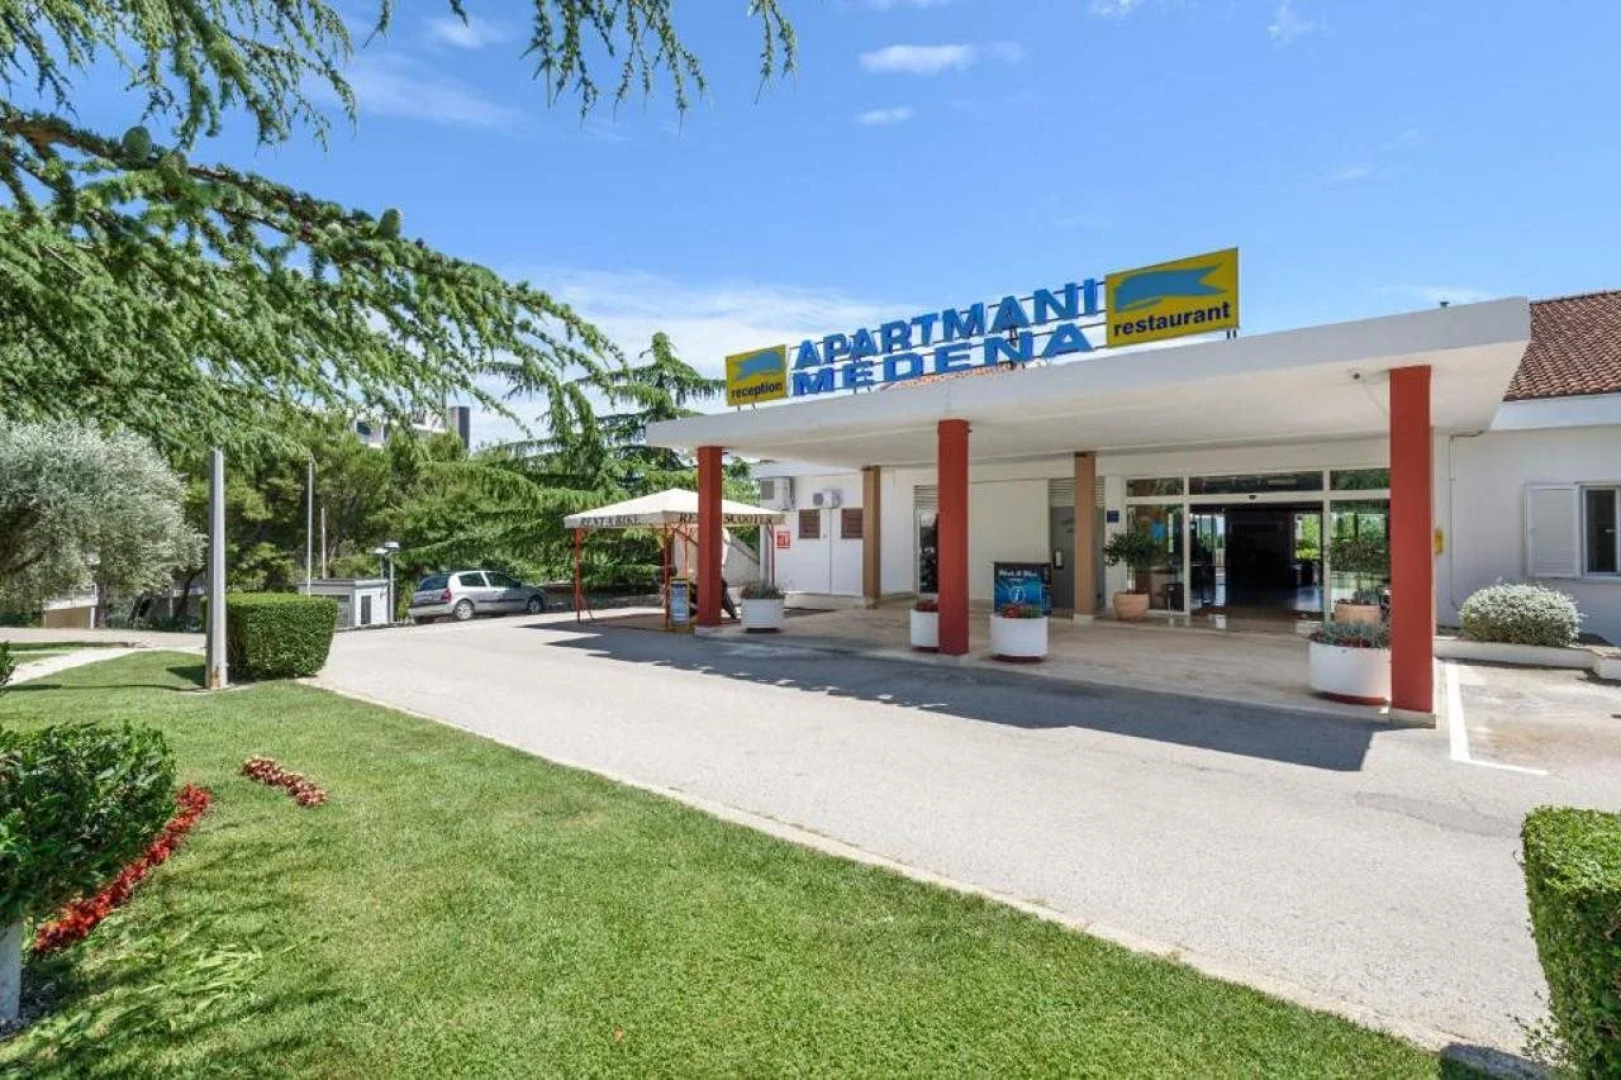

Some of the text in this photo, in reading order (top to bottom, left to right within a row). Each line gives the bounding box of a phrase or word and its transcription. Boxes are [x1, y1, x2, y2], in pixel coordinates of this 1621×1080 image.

[794, 278, 1098, 369] APARTMANI
[1113, 301, 1231, 337] restaurant
[792, 322, 1095, 396] MEDENA
[731, 382, 783, 398] reception
